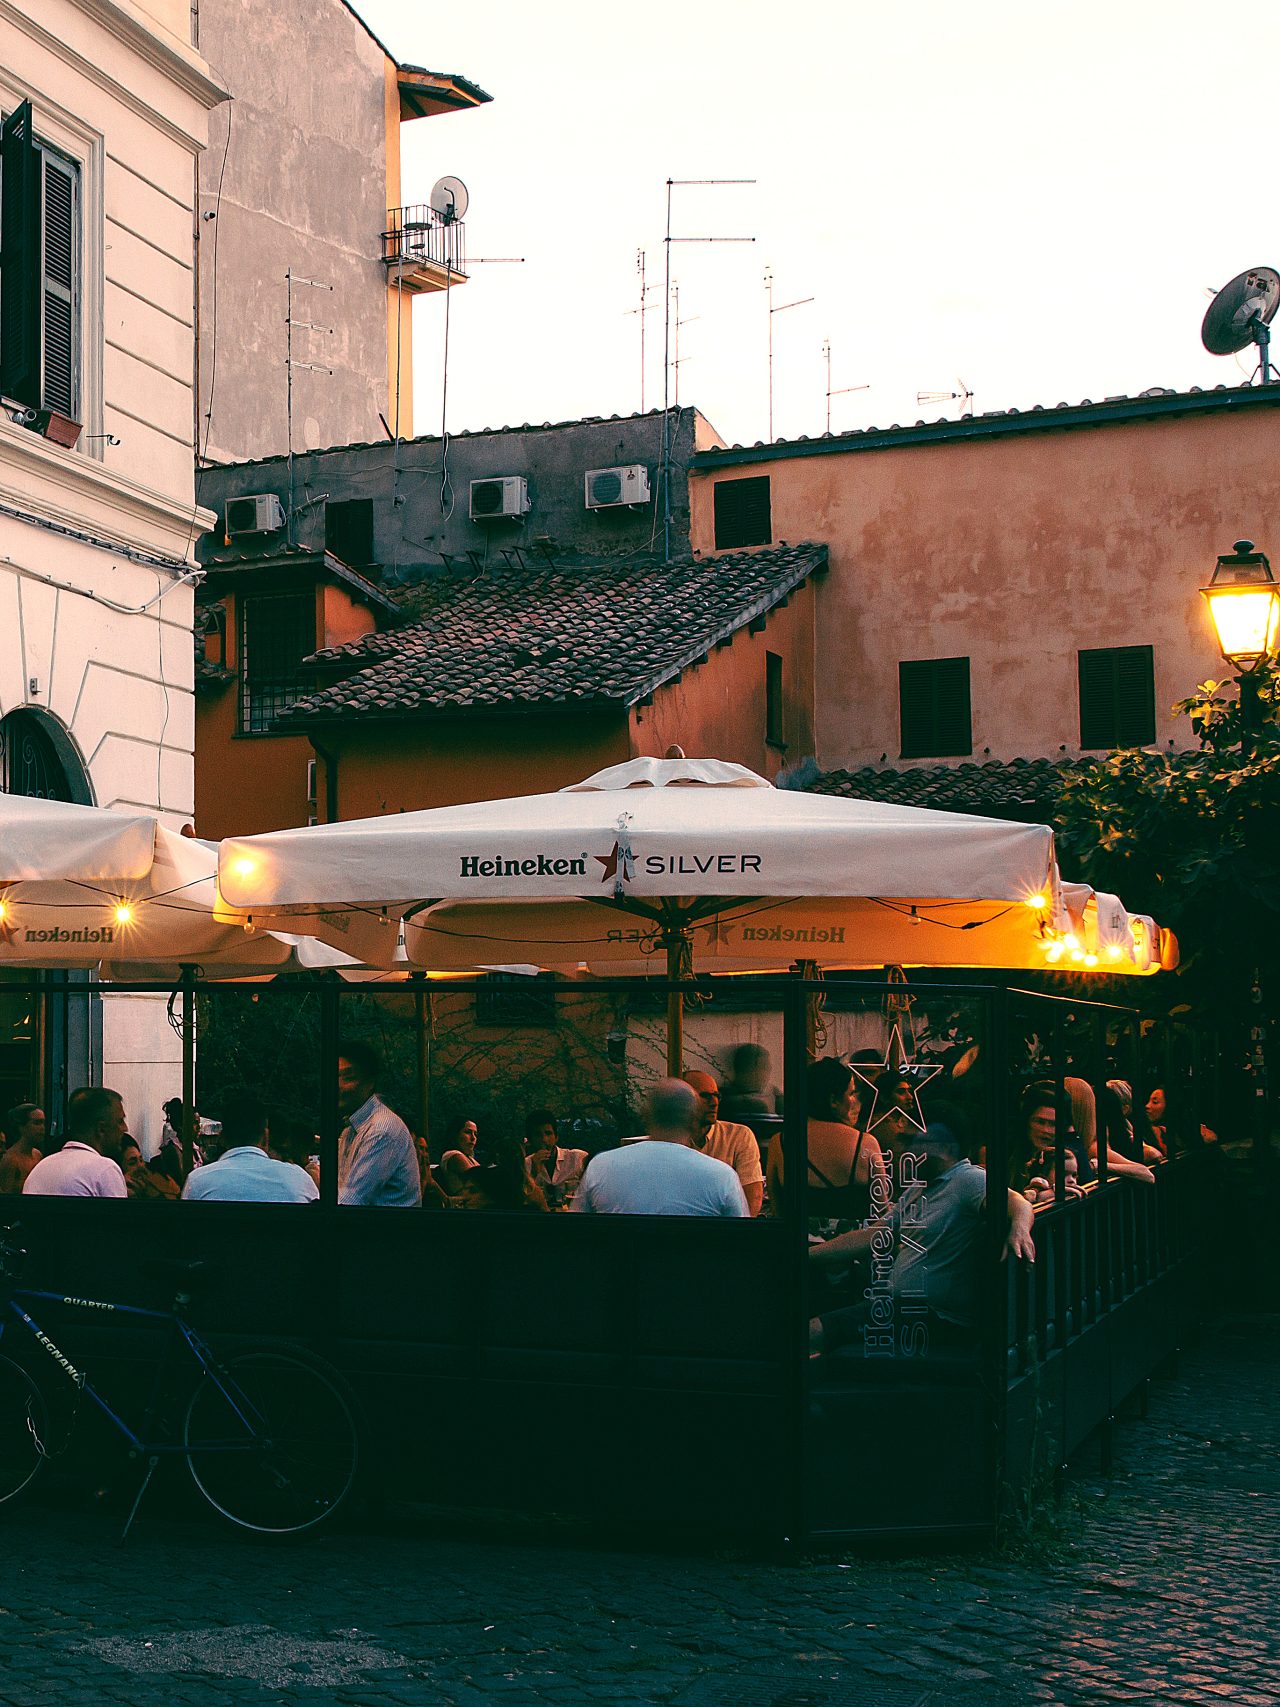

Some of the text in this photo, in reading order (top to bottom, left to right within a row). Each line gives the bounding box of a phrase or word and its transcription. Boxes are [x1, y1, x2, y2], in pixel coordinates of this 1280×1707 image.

[459, 854, 762, 878] Heineken SILVER
[863, 1149, 896, 1358] Heineken
[900, 1151, 929, 1357] SILVER
[63, 1296, 115, 1311] QUARTER
[34, 1330, 82, 1382] LEGNANO
